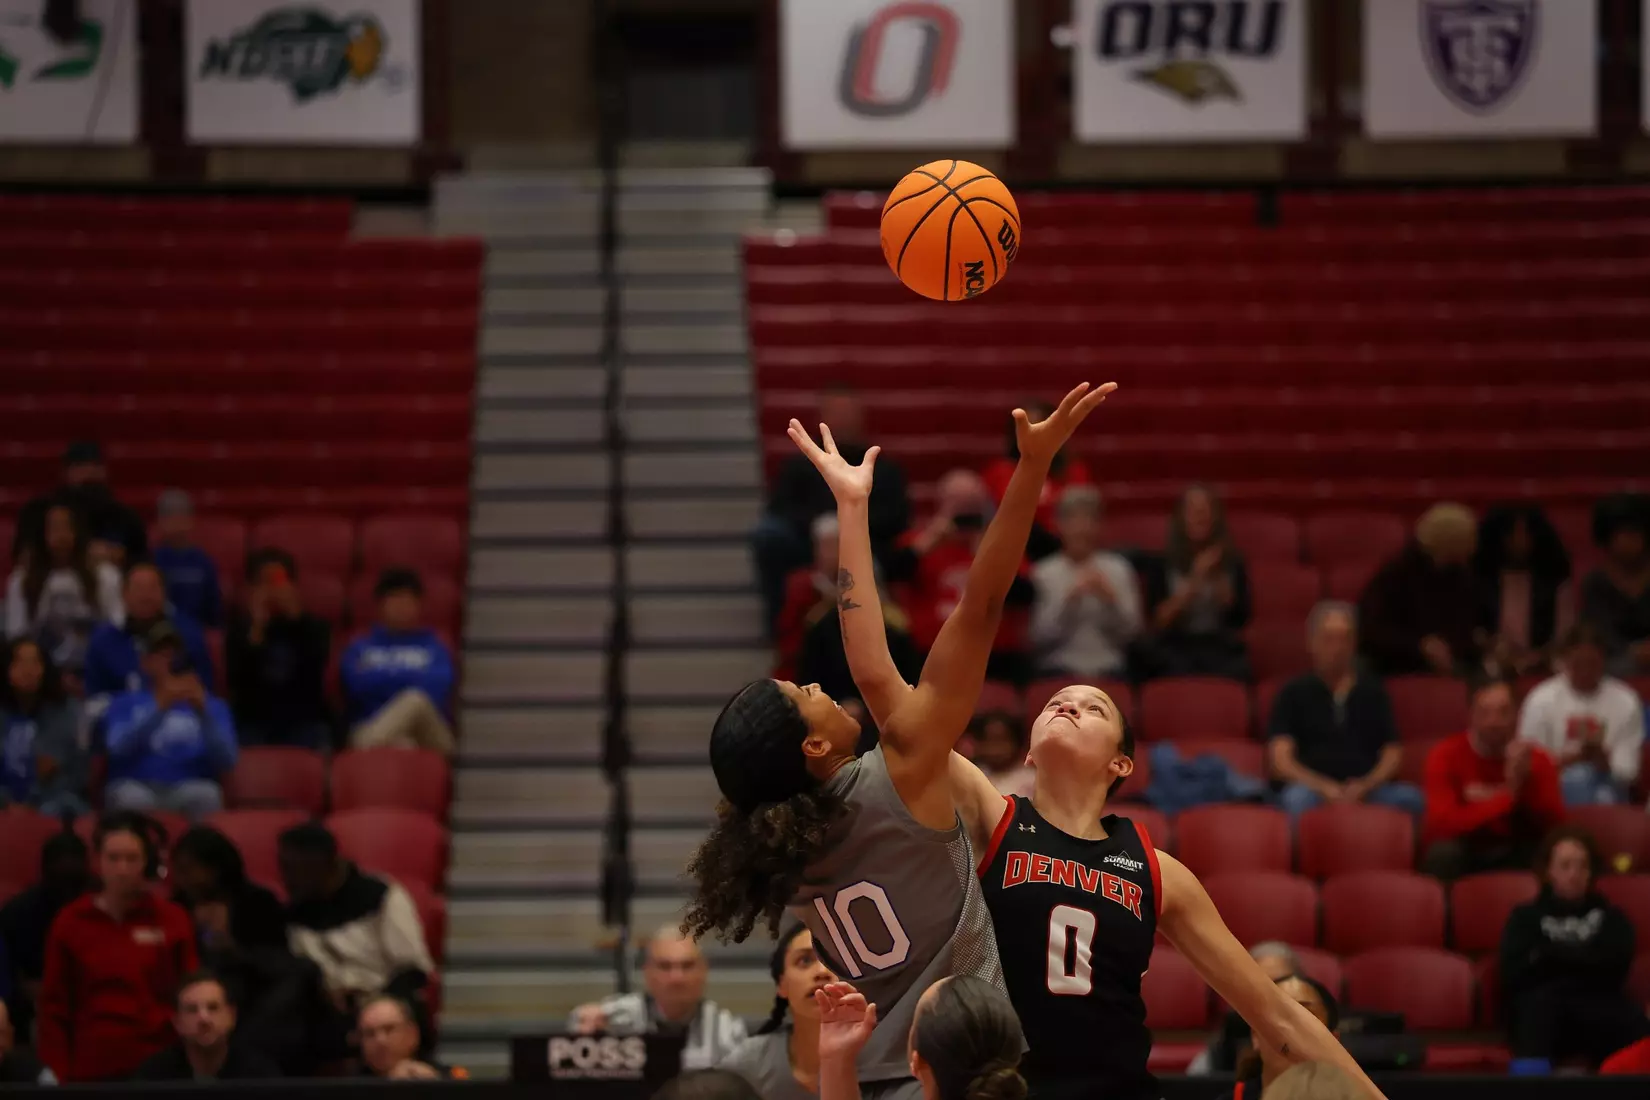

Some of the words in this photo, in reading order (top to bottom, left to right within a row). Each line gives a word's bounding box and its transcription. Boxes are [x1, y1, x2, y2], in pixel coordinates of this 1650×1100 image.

[1097, 0, 1285, 61] ORU
[1002, 850, 1143, 922] DENVER
[1103, 855, 1144, 870] SUMMIT
[813, 880, 912, 979] 10
[1046, 904, 1097, 996] 0
[547, 1036, 647, 1069] POSS
